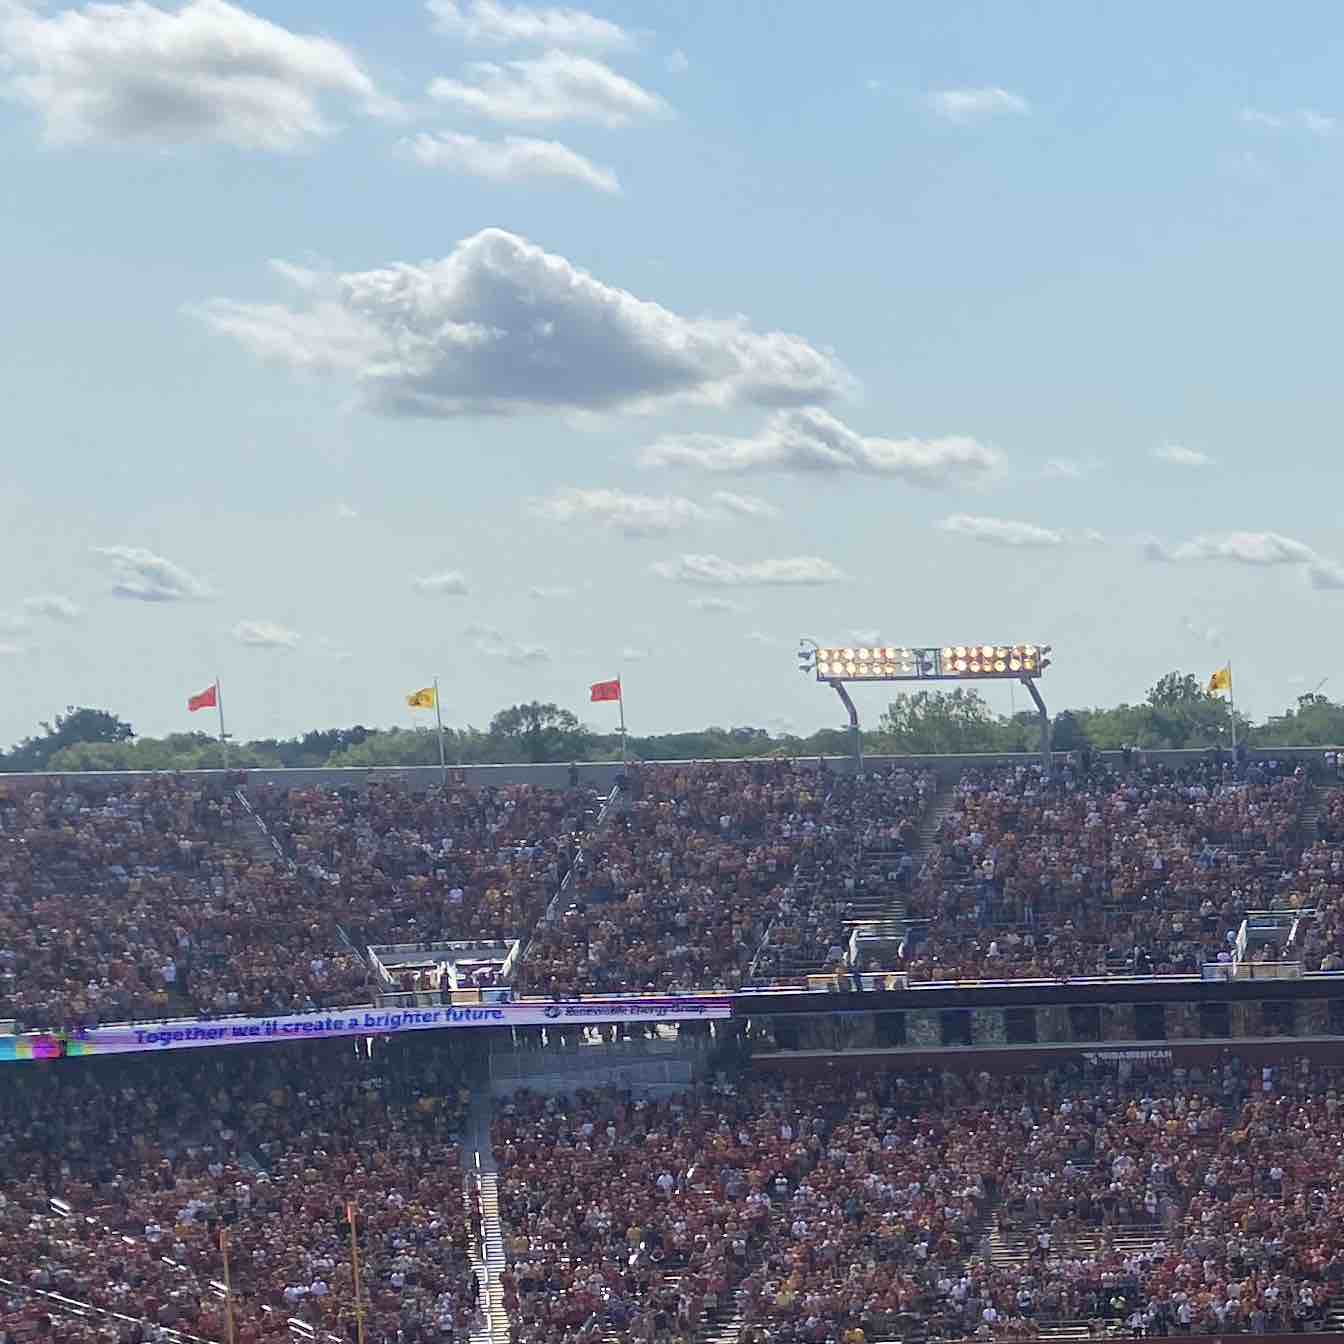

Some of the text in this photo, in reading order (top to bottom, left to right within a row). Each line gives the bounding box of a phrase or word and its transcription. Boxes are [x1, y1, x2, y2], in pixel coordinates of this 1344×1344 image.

[133, 1027, 226, 1048] Together
[231, 1020, 279, 1038] we'll
[281, 1018, 344, 1035] create
[348, 1017, 360, 1028] a
[364, 1007, 440, 1032] brighter
